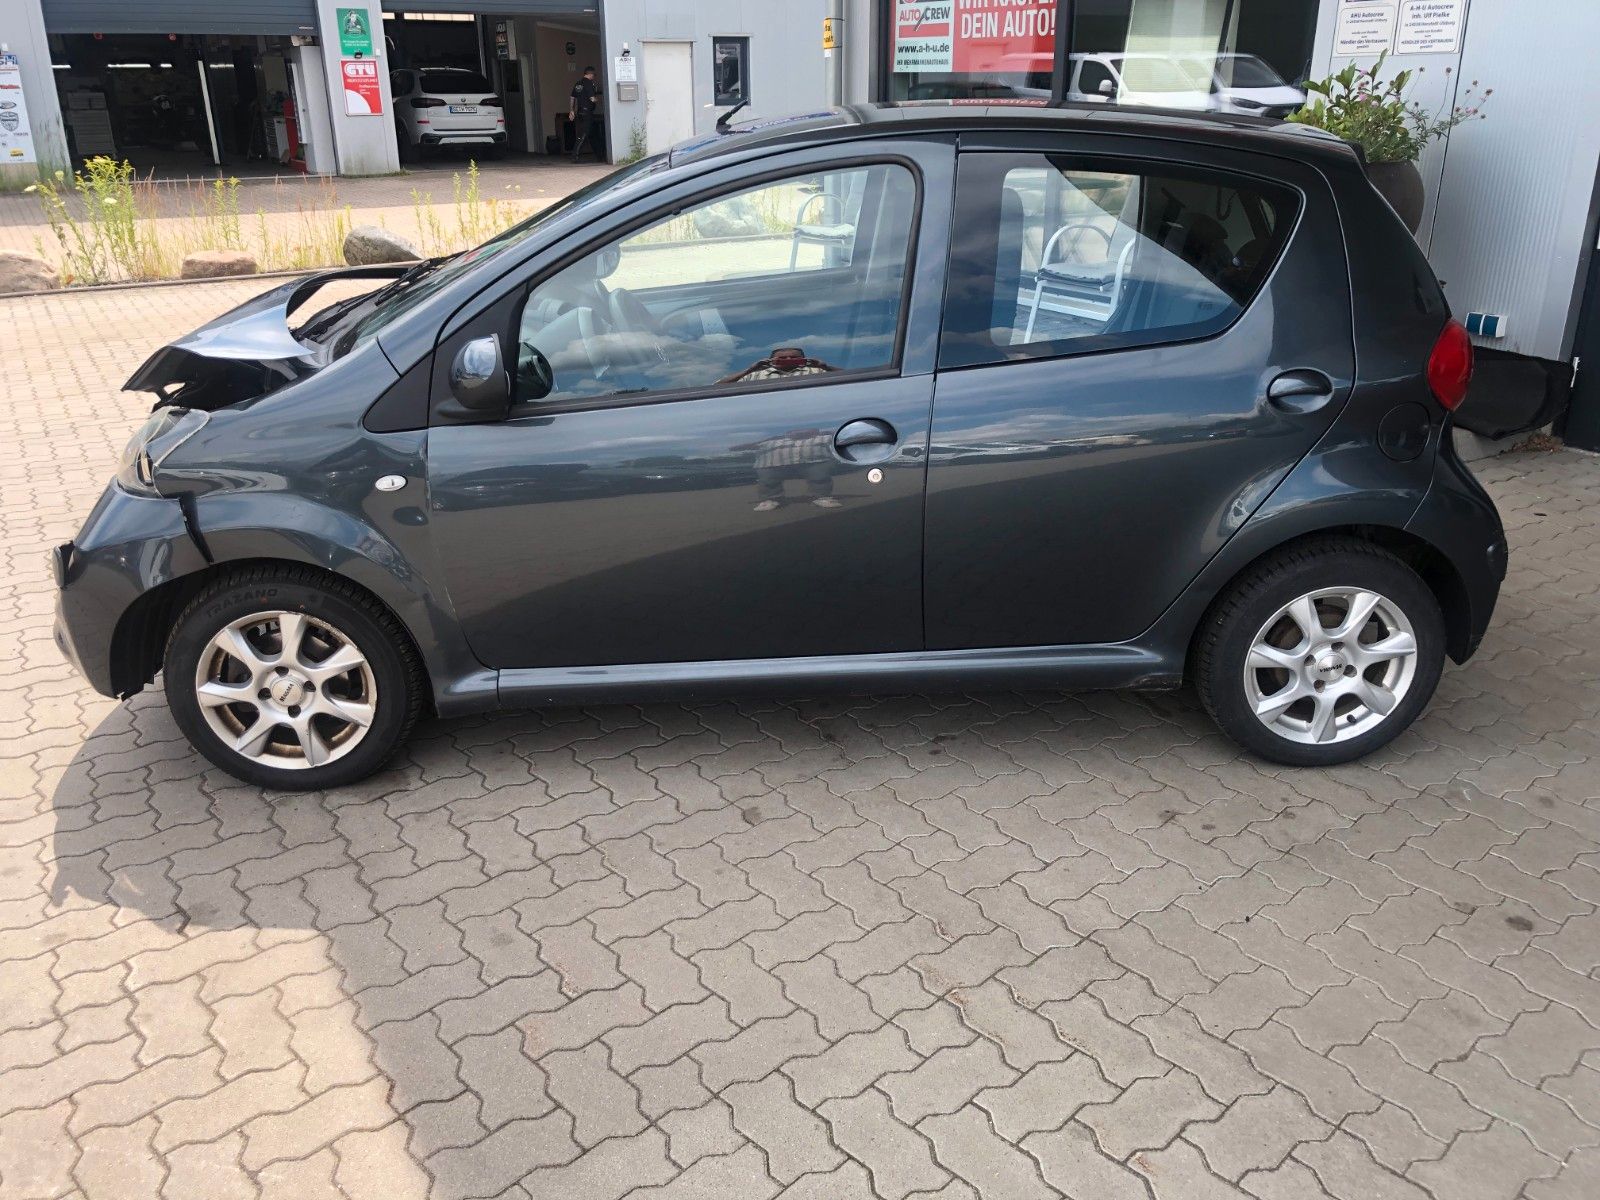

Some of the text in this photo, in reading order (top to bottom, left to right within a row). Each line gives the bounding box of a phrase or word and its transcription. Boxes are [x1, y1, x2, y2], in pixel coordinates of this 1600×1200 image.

[900, 7, 950, 22] AUTO CREW
[961, 8, 1056, 39] DEIN AUTO!
[898, 43, 950, 54] www.a-h-u.de
